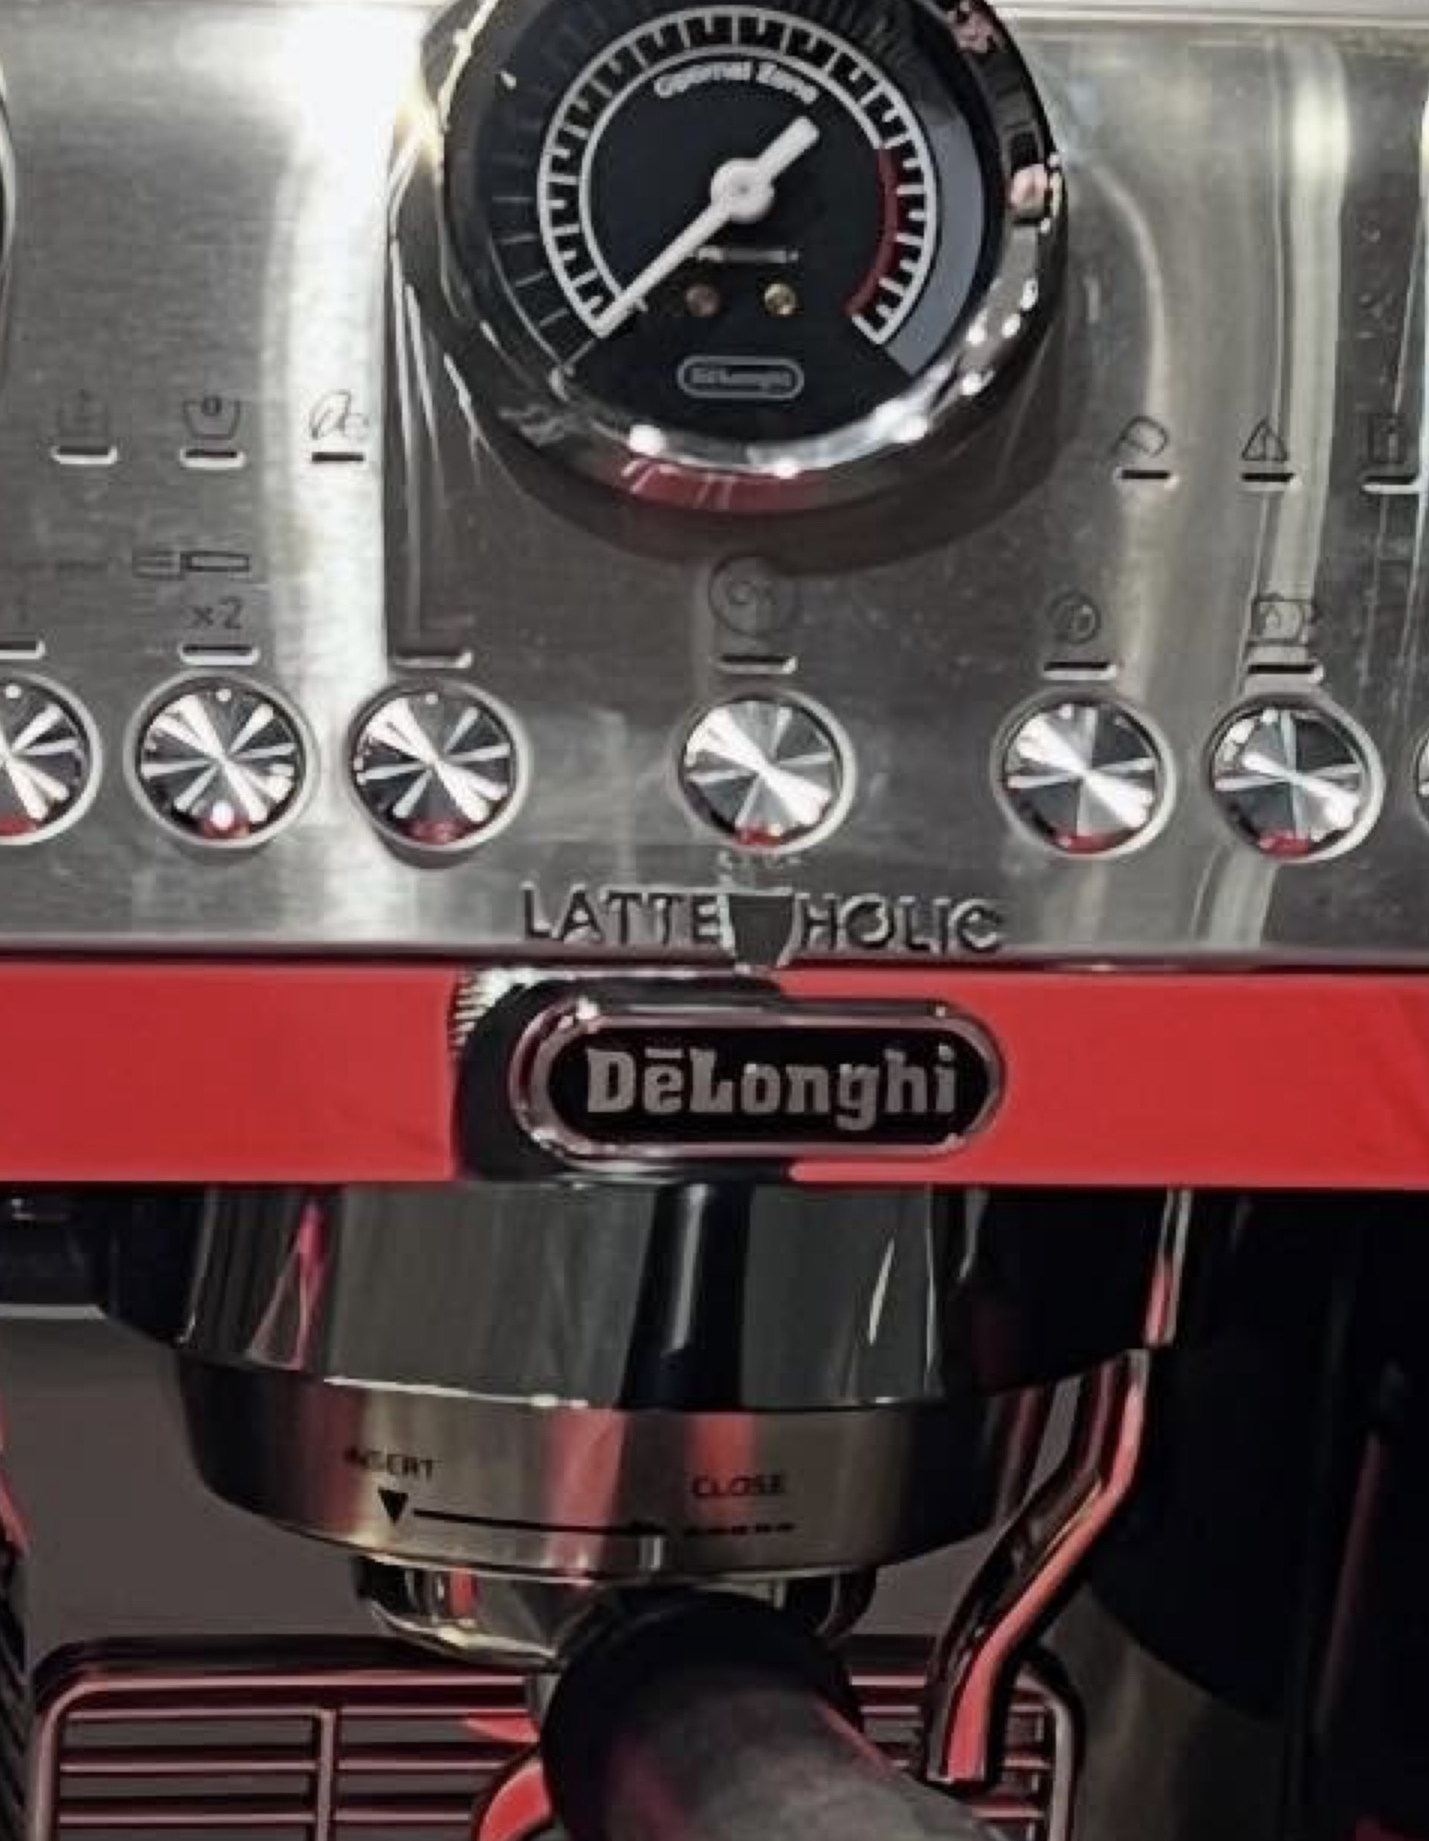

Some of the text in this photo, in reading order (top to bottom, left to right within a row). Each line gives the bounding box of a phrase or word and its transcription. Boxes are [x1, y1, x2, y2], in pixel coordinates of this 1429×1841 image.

[522, 881, 1005, 956] LATTE HOLIC
[690, 1472, 792, 1500] CLOSE
